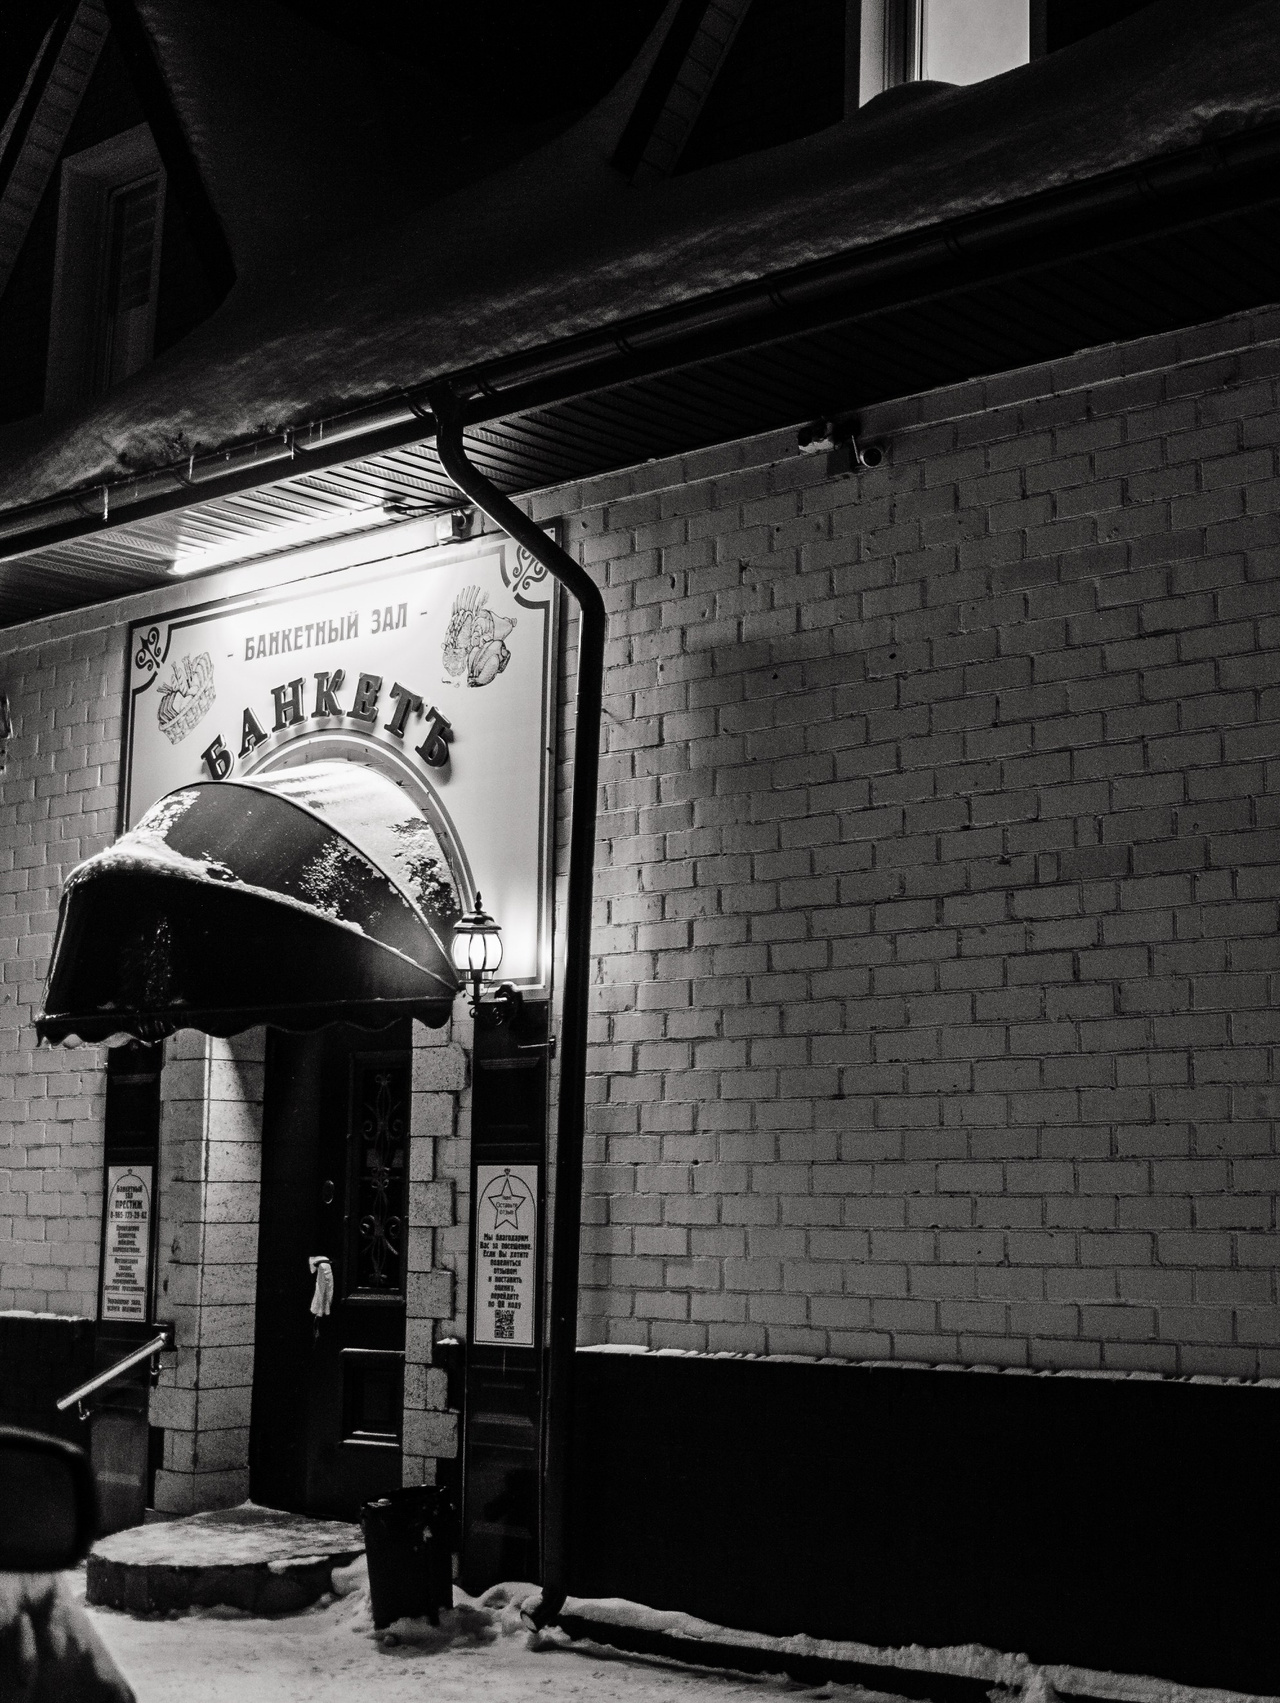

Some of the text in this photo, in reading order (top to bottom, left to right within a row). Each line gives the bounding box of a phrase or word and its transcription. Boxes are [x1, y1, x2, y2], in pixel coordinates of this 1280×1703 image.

[244, 602, 409, 662] БАНКЕТНЫЙ ЗАЛ
[200, 668, 455, 781] БАНКЕТЪ
